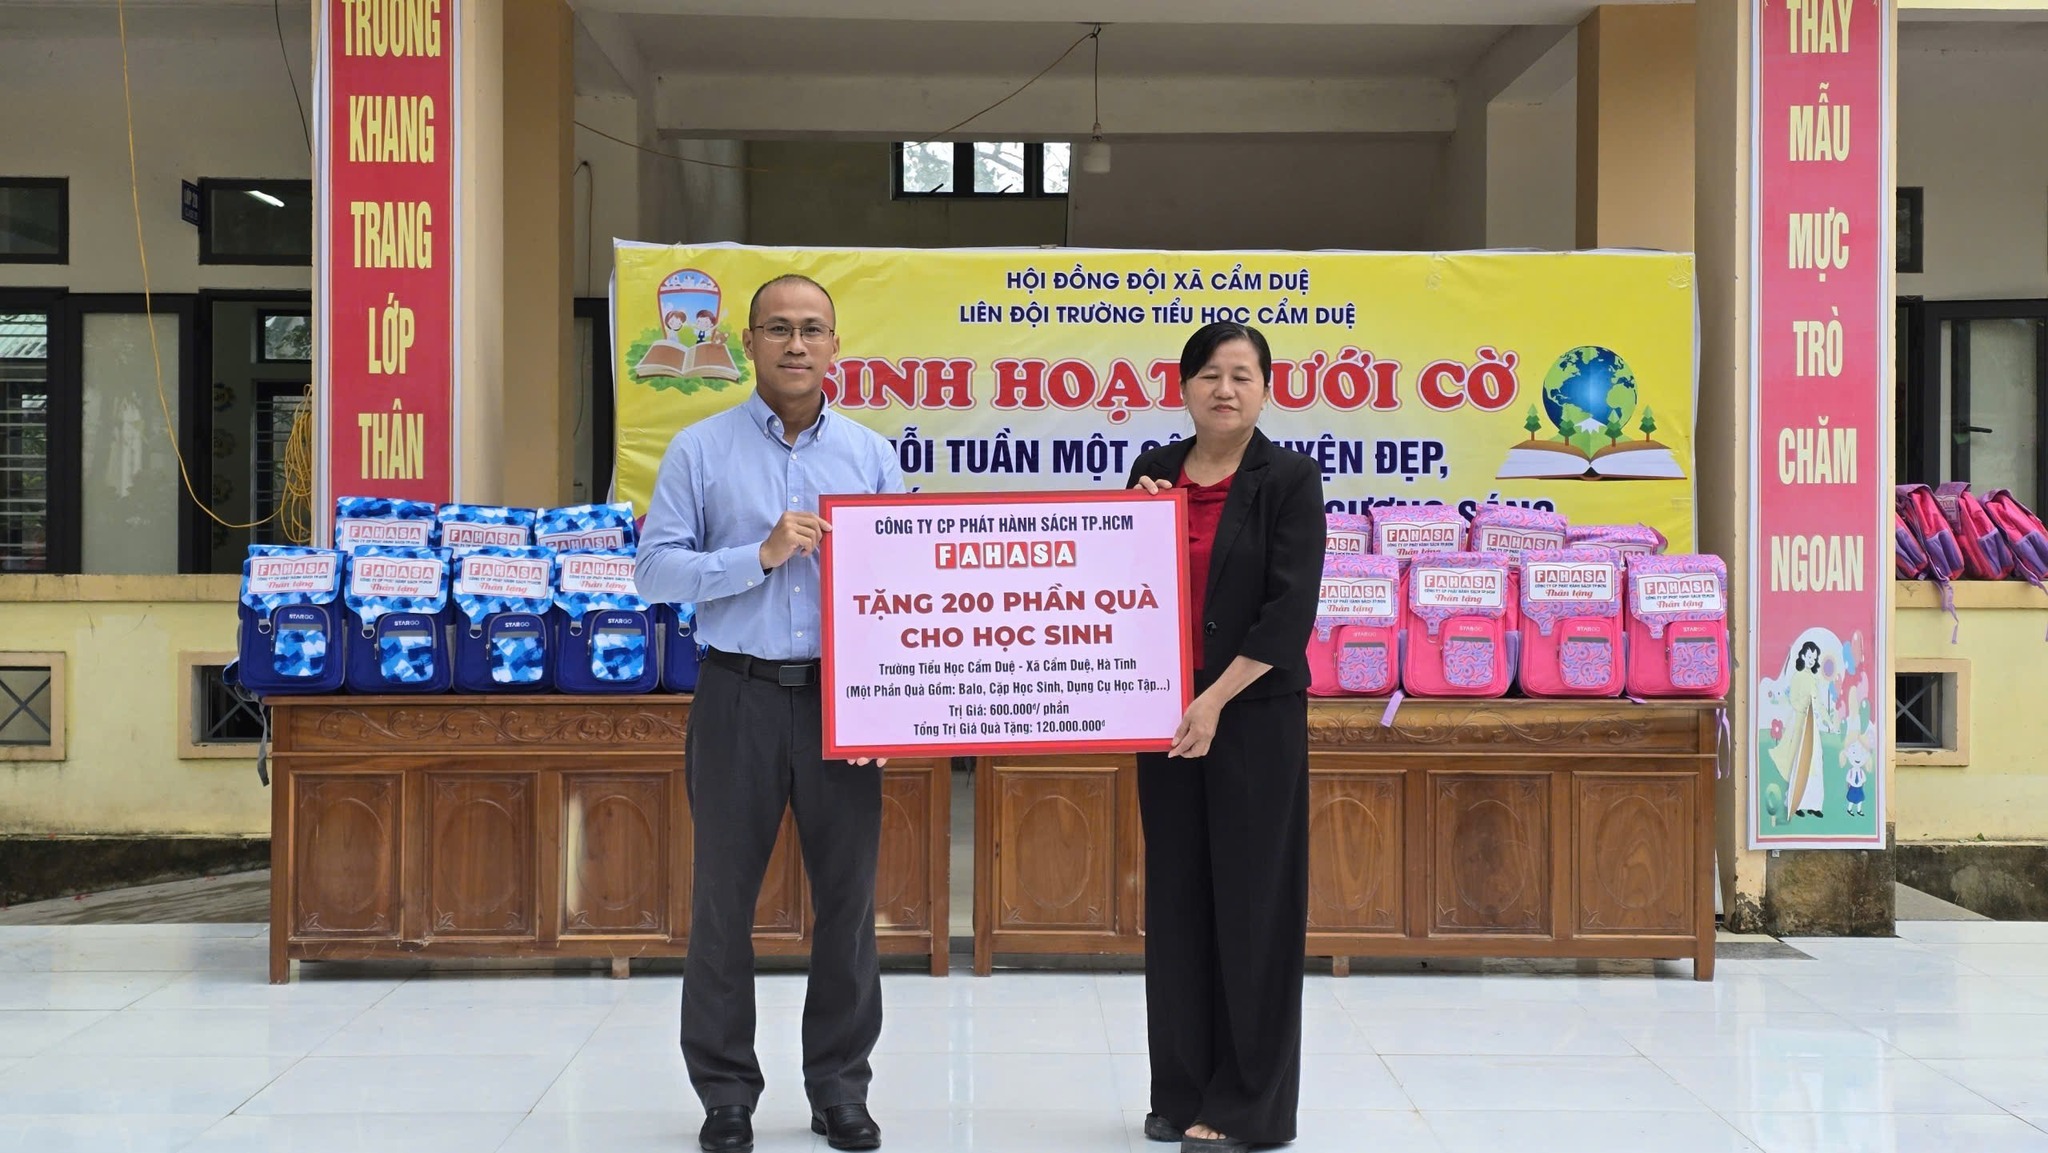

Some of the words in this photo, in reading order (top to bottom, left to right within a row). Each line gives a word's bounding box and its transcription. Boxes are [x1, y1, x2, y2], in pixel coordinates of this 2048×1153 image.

[350, 95, 434, 163] KHANG
[1790, 82, 1850, 161] MẪU
[351, 201, 432, 269] TRANG
[1789, 207, 1849, 282] MỰC
[1007, 267, 1045, 294] HỘI
[1053, 264, 1119, 291] ĐỒNG
[1126, 267, 1165, 294] ĐỘI
[1173, 268, 1204, 291] XÃ
[1211, 263, 1262, 291] CẨM
[1269, 267, 1310, 294] DUỆ
[960, 302, 1002, 324] LIÊN
[1010, 301, 1049, 328] ĐỘI
[1056, 302, 1146, 324] TRƯỜNG
[1151, 297, 1194, 324] TIỂU
[1257, 297, 1308, 324] CẨM
[1315, 302, 1356, 329] DUỆ
[368, 293, 415, 375] LỚP
[1793, 306, 1843, 377] TRÒ
[993, 358, 1185, 423] HOẠT
[1271, 347, 1401, 410] ƯỚI
[1418, 347, 1518, 410] CỜ
[358, 398, 424, 480] THÂN
[1778, 415, 1857, 485] CHĂM
[888, 427, 933, 472] ỖI
[947, 428, 1039, 473] TUẦN
[1052, 433, 1128, 481] MỘT
[1375, 441, 1448, 481] ĐẸP,
[350, 526, 421, 539] FAHASA
[875, 516, 913, 535] CÔNG
[917, 518, 932, 534] TY
[937, 517, 955, 534] CP
[960, 514, 995, 533] PHÁT
[999, 513, 1036, 533] HÀNH
[1041, 513, 1077, 532] SÁCH
[1082, 515, 1133, 531] TP.HCM
[450, 529, 520, 546] FAHASA
[1326, 538, 1360, 551] ASA
[1387, 529, 1454, 542] FAHASA
[1488, 533, 1557, 551] FAHASA
[935, 540, 1076, 569] FAHASA
[1771, 535, 1864, 592] NGOAN
[258, 562, 330, 576] FAHASA
[361, 564, 434, 579] FAHASA
[470, 563, 542, 580] FAHASA
[570, 561, 635, 577] FAHAS
[1535, 570, 1606, 583] FAHASA
[1425, 575, 1496, 589] FAHASA
[1644, 580, 1714, 595] FAHASA
[853, 588, 933, 620] TẶNG
[941, 592, 994, 613] 200
[1004, 583, 1085, 612] PHẦN
[1095, 583, 1158, 614] QUÀ
[901, 627, 964, 648] CHO
[973, 626, 1036, 652] HỌC
[1044, 624, 1113, 645] SINH
[879, 663, 915, 675] Trường
[919, 659, 940, 674] Tiểu
[944, 662, 964, 676] Học
[968, 659, 991, 673] Cẩm
[995, 661, 1015, 675] Duệ
[1026, 660, 1040, 672] Xã
[1043, 657, 1067, 672] Cẩm
[1070, 659, 1094, 673] Duệ,
[1097, 659, 1111, 671] Hà
[1113, 658, 1137, 670] Tĩnh
[846, 685, 871, 699] (Một
[874, 682, 901, 697] Phần
[904, 683, 925, 697] Quà
[928, 682, 956, 696] Gồm:
[958, 683, 986, 696] Balo,
[989, 682, 1009, 696] Cặp
[1013, 681, 1033, 696] Học
[1036, 681, 1064, 694] Sinh,
[1067, 680, 1094, 695] Dụng
[1097, 679, 1111, 694] Cụ
[1114, 679, 1134, 694] Học
[1137, 678, 1171, 694] Tập...)
[949, 704, 962, 719] Trị
[966, 704, 987, 716] Giá:
[1043, 700, 1069, 716] phần
[913, 720, 939, 737] Tổng
[942, 723, 956, 737] Trị
[959, 722, 977, 735] Giá
[980, 721, 1001, 735] Quà
[1004, 721, 1033, 736] Tặng:
